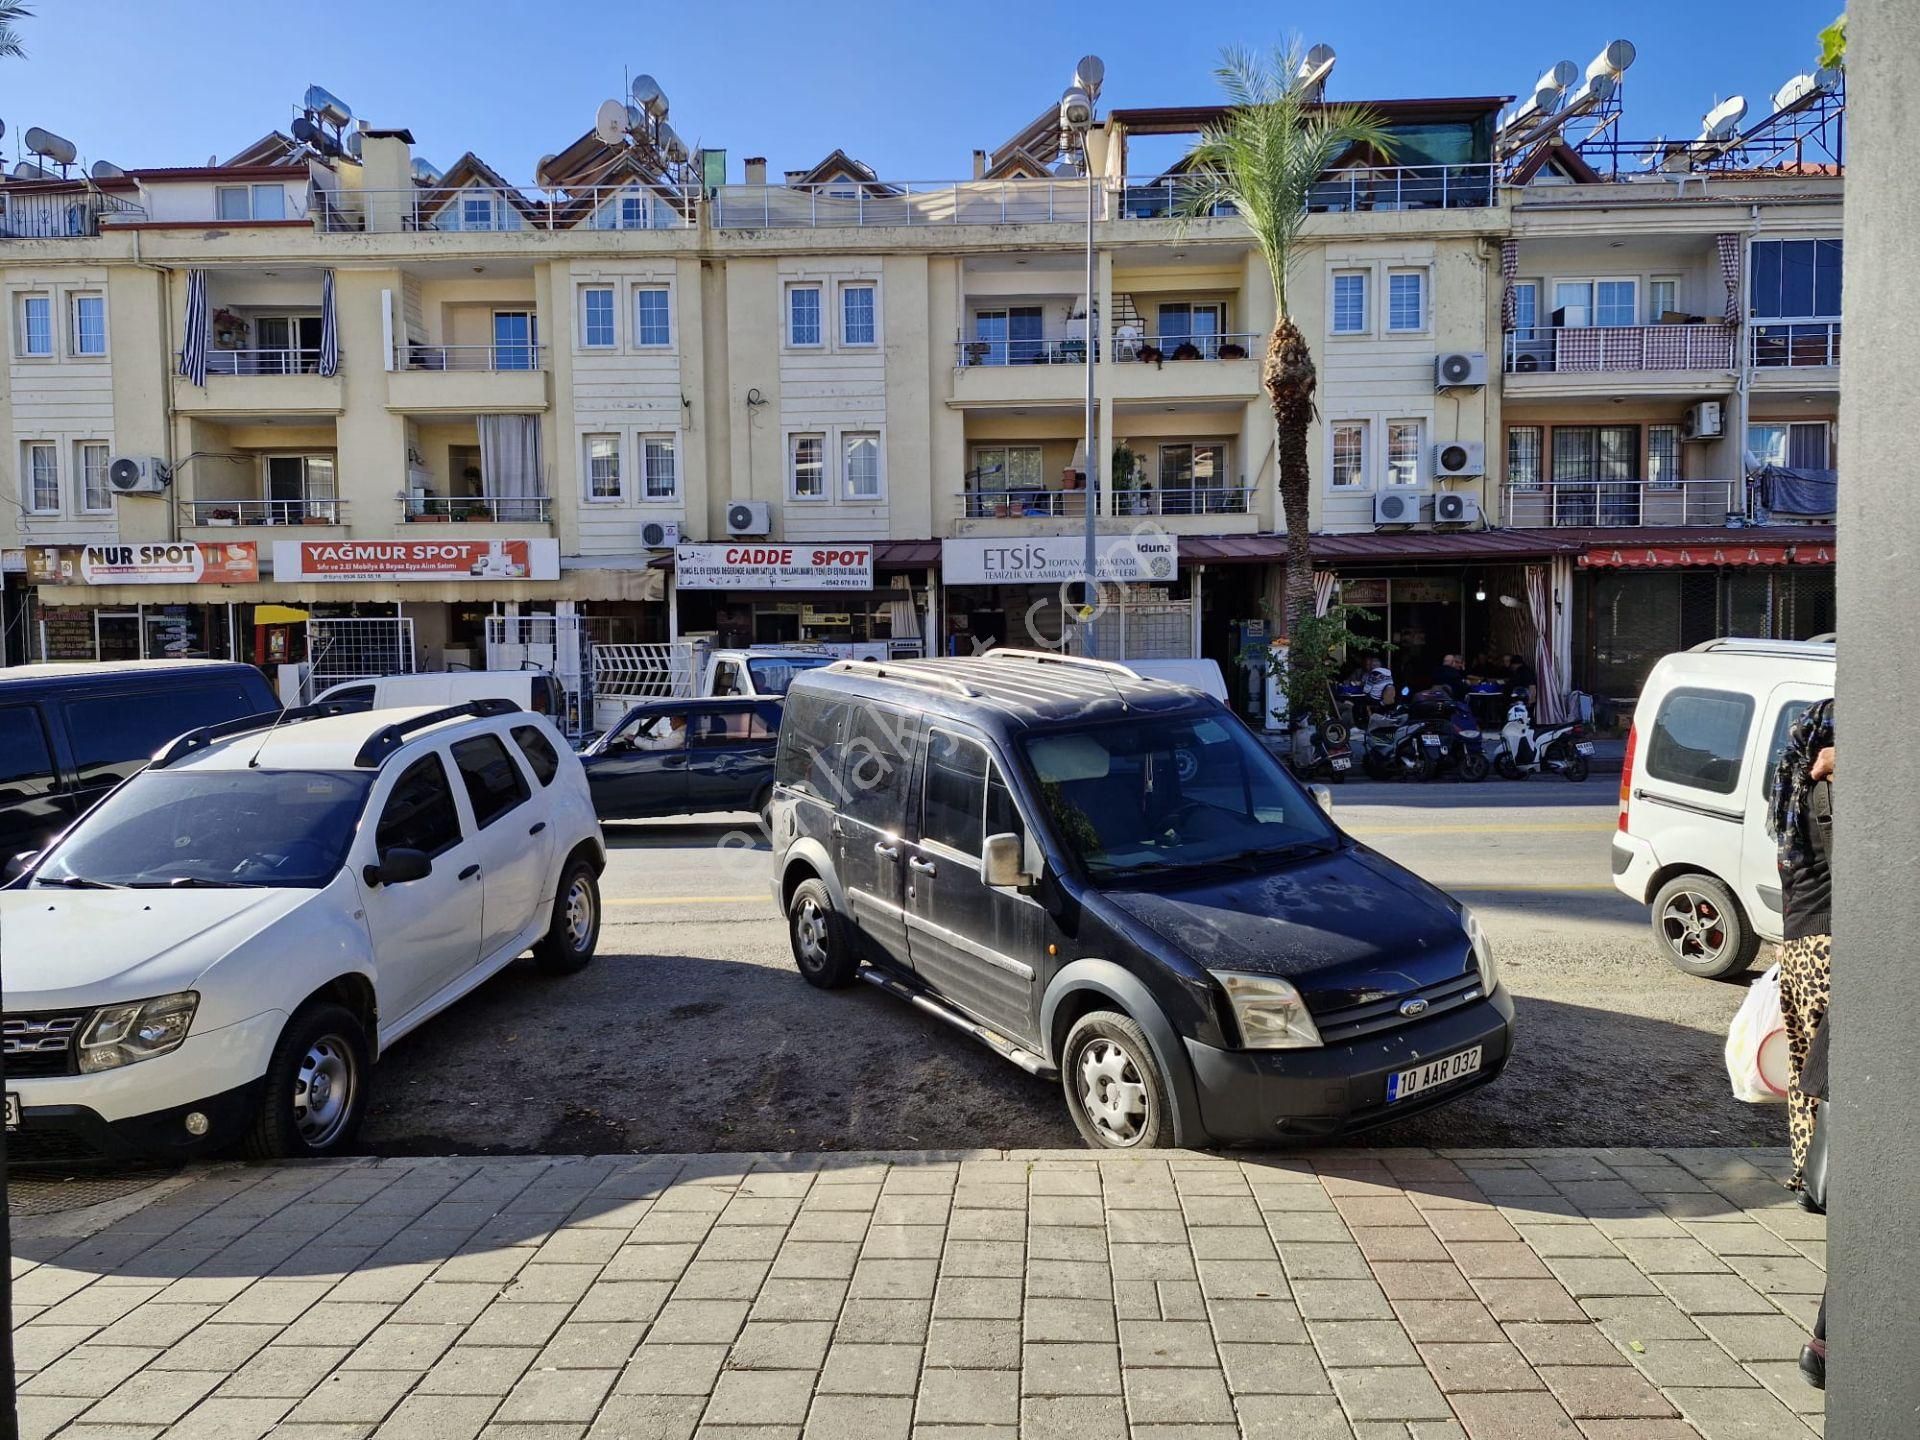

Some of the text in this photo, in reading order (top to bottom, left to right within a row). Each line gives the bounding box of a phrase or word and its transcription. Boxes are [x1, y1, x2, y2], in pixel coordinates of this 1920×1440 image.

[87, 545, 195, 565] NUR SPOT
[308, 543, 471, 560] YAĞMUR SPOT
[725, 548, 793, 565] CADDE
[811, 550, 869, 566] SPOT
[983, 543, 1046, 570] ETSİS
[1048, 559, 1080, 567] TOPTAN
[353, 563, 378, 571] Mobilya
[385, 563, 405, 571] Beyaz
[1024, 570, 1034, 578] VE
[1401, 1071, 1417, 1094] 10
[1422, 1060, 1449, 1087] AAR
[1452, 1050, 1478, 1075] 032
